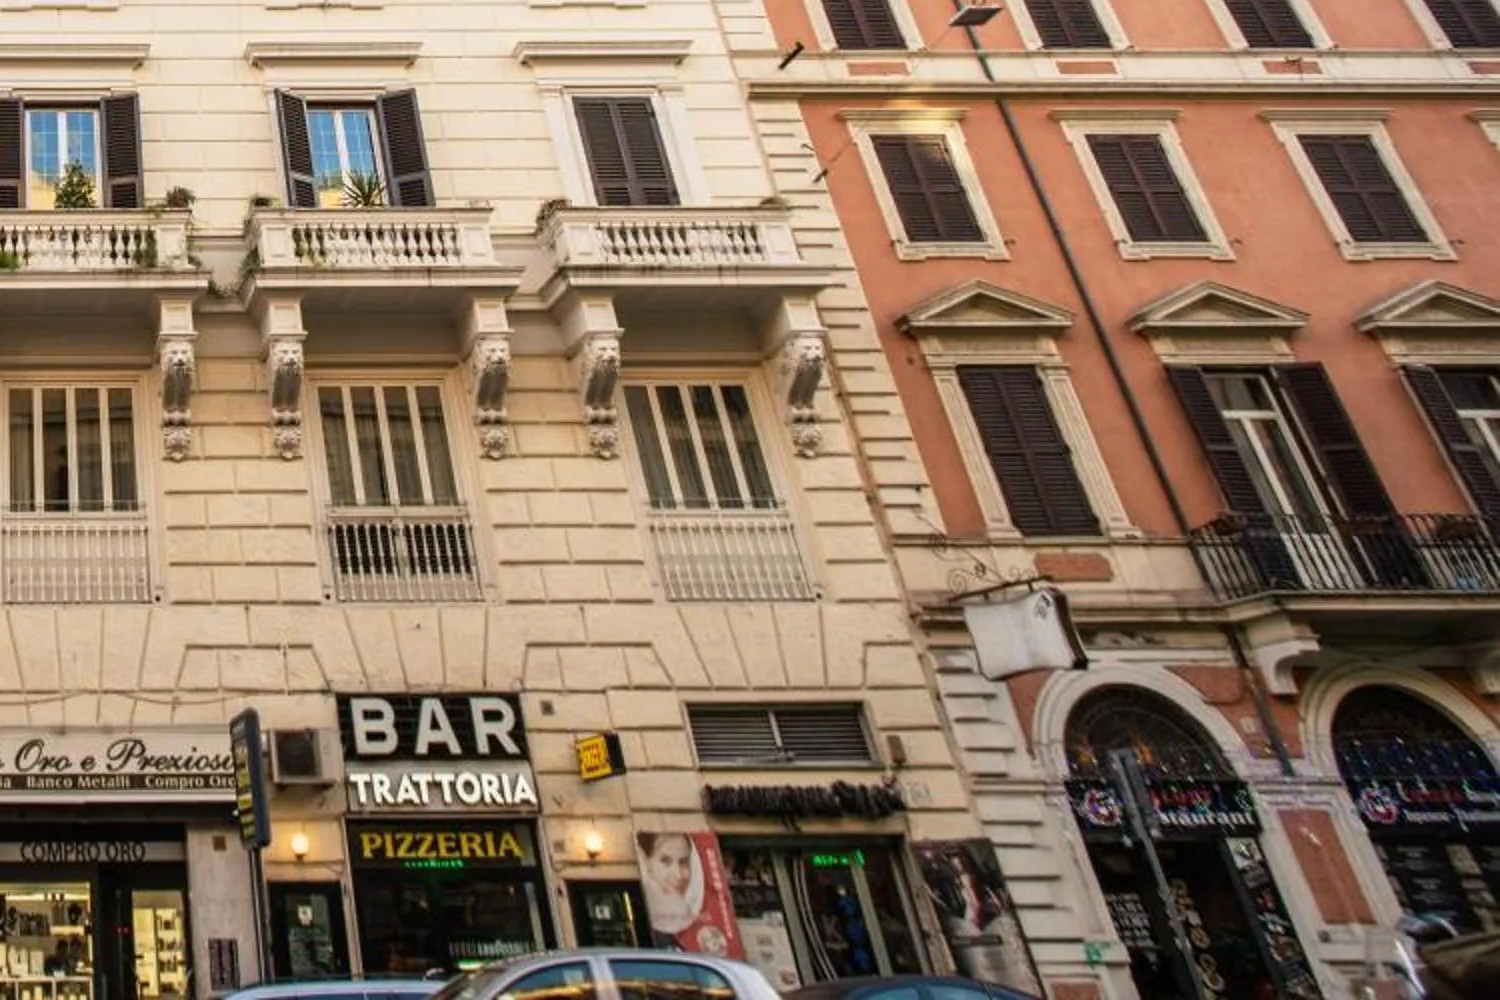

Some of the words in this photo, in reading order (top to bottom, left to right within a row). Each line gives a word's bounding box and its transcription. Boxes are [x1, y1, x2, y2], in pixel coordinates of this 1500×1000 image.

[350, 696, 522, 756] BAR
[14, 737, 72, 773] Oro
[80, 756, 97, 772] e
[25, 775, 73, 789] Banco
[77, 774, 132, 789] Metalli
[144, 775, 205, 792] Compro
[209, 775, 237, 789] Oro
[350, 771, 538, 805] TRATTORIA
[20, 840, 101, 863] COMPRO
[105, 840, 146, 863] ORO
[360, 831, 524, 859] PIZZERIA
